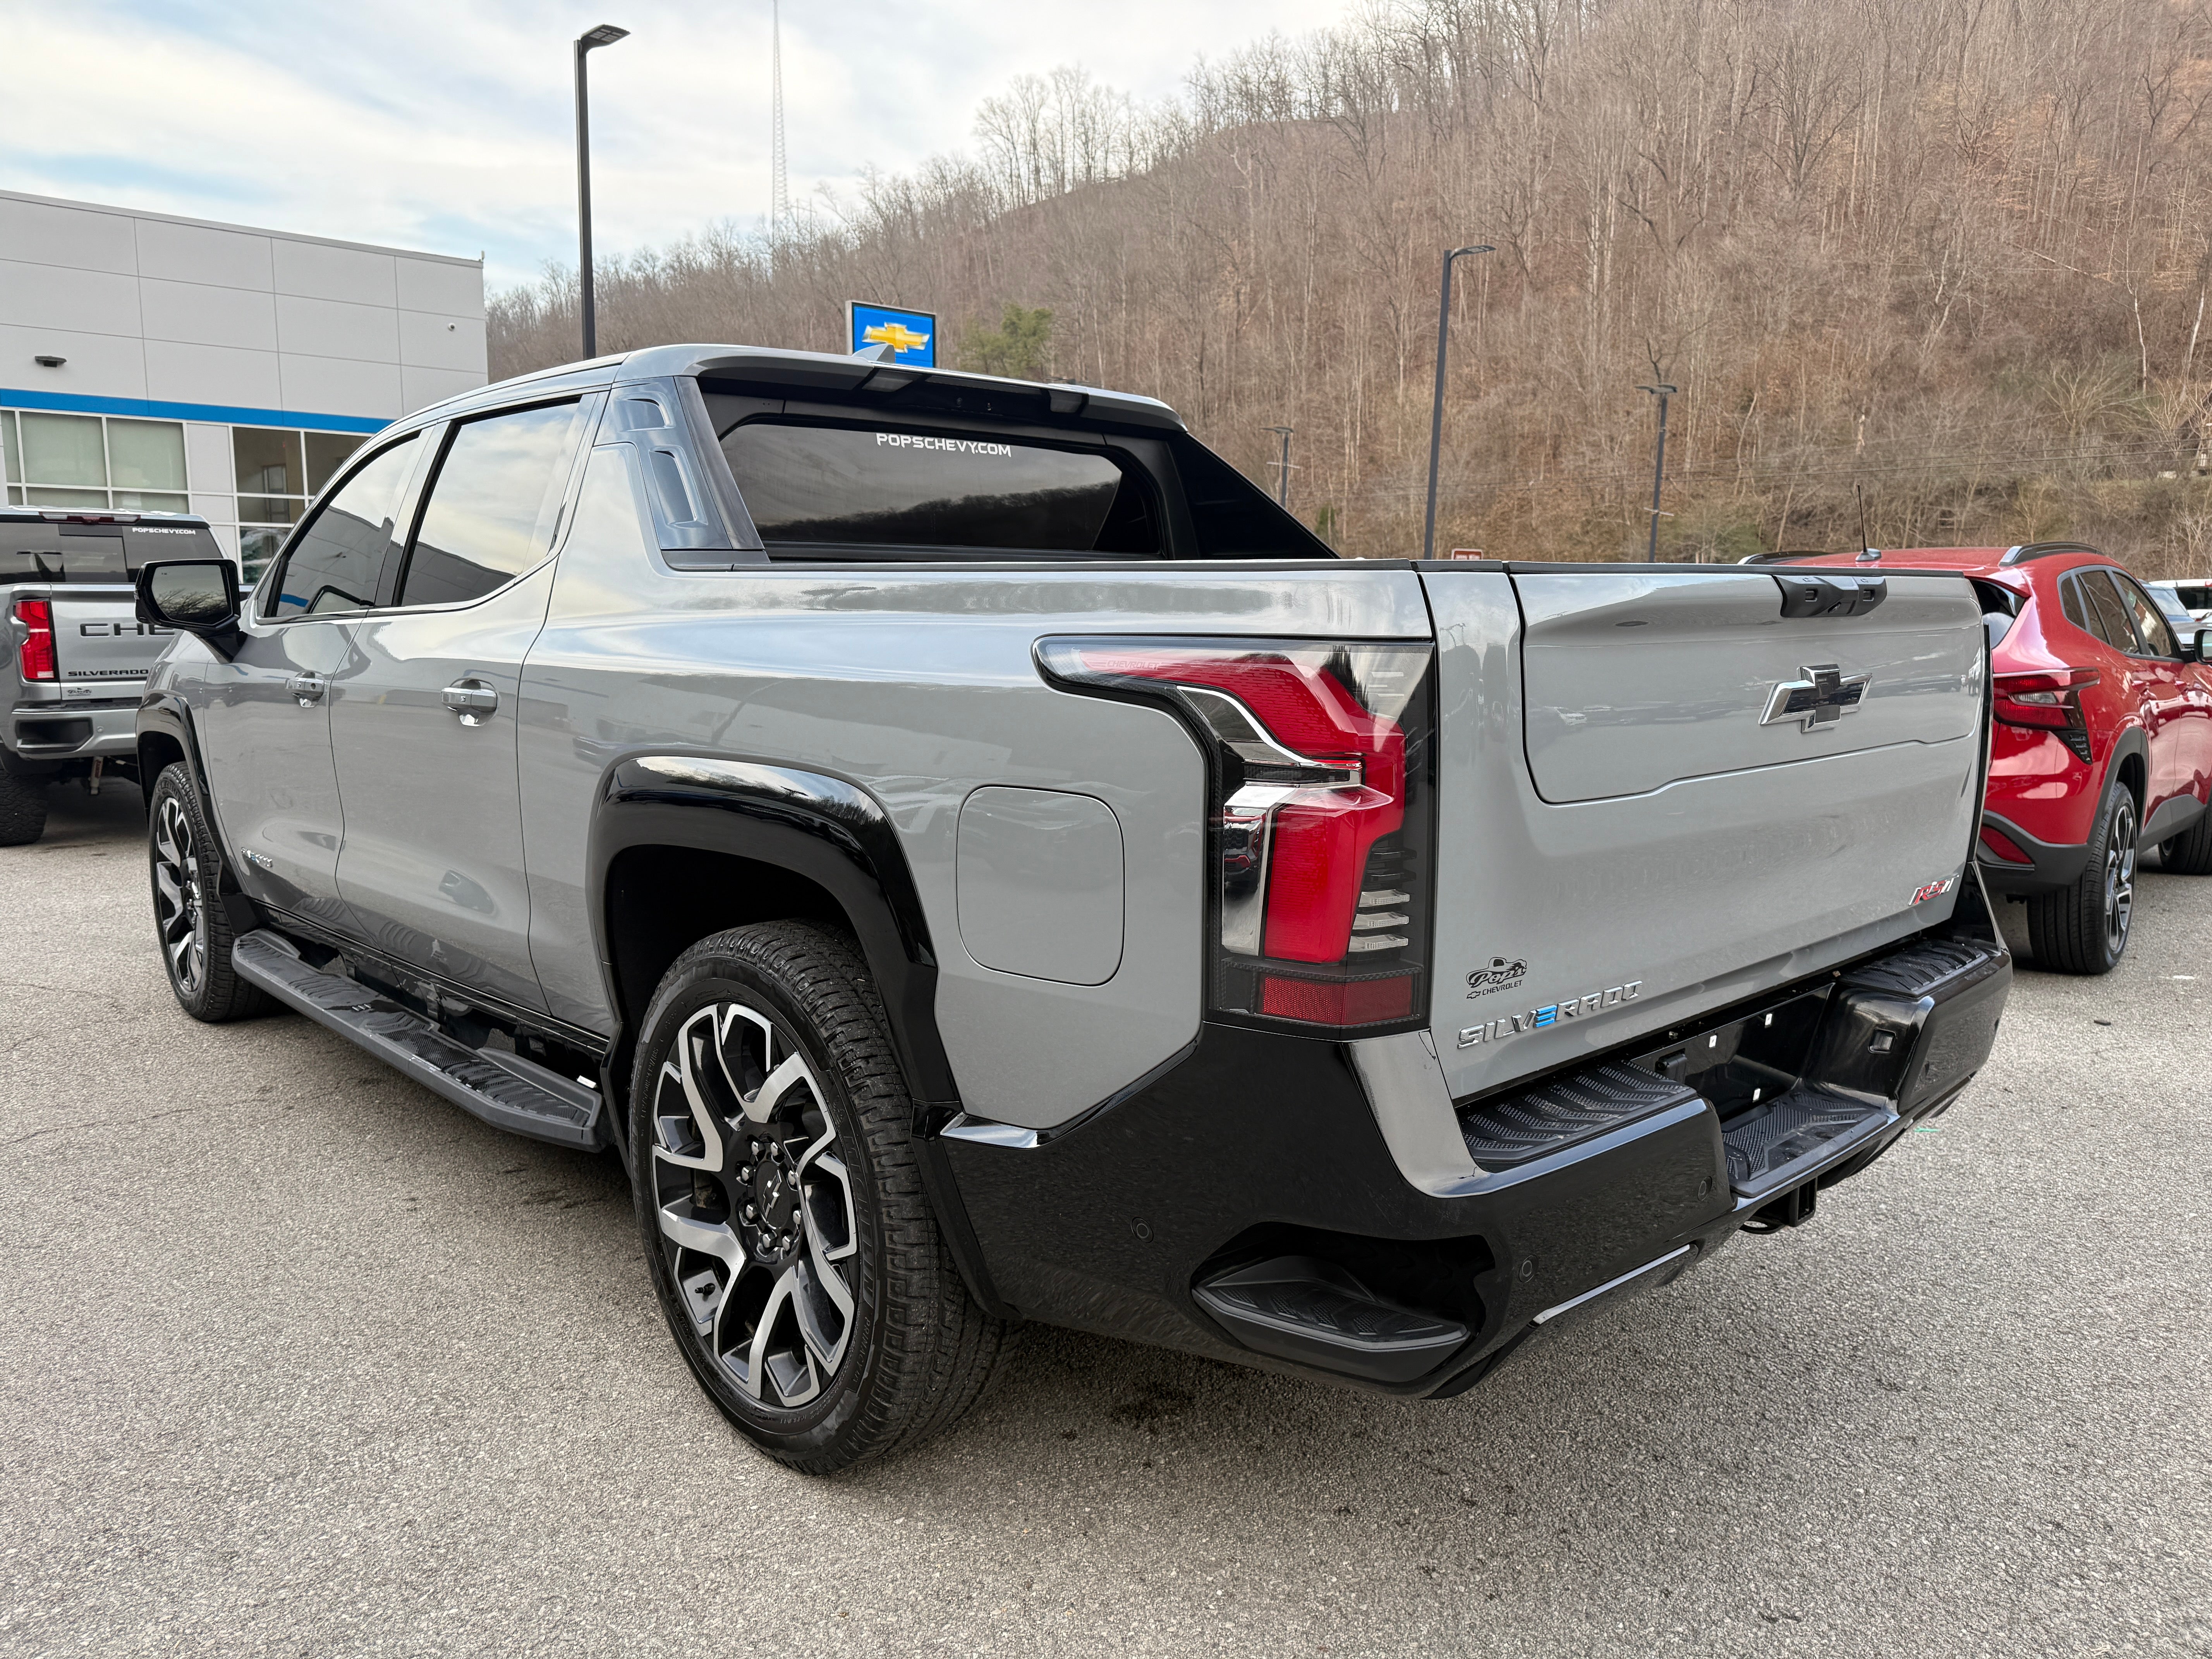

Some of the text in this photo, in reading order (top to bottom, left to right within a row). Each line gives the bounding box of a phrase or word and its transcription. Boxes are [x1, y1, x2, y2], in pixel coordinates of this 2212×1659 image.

[876, 433, 1012, 457] POPSCHEVY.COM
[1457, 980, 1644, 1049] SILVERADO
[1482, 980, 1522, 996] CHEVROLET
[843, 1135, 874, 1295] MICHELIN
[857, 1317, 871, 1371] PRIMACY
